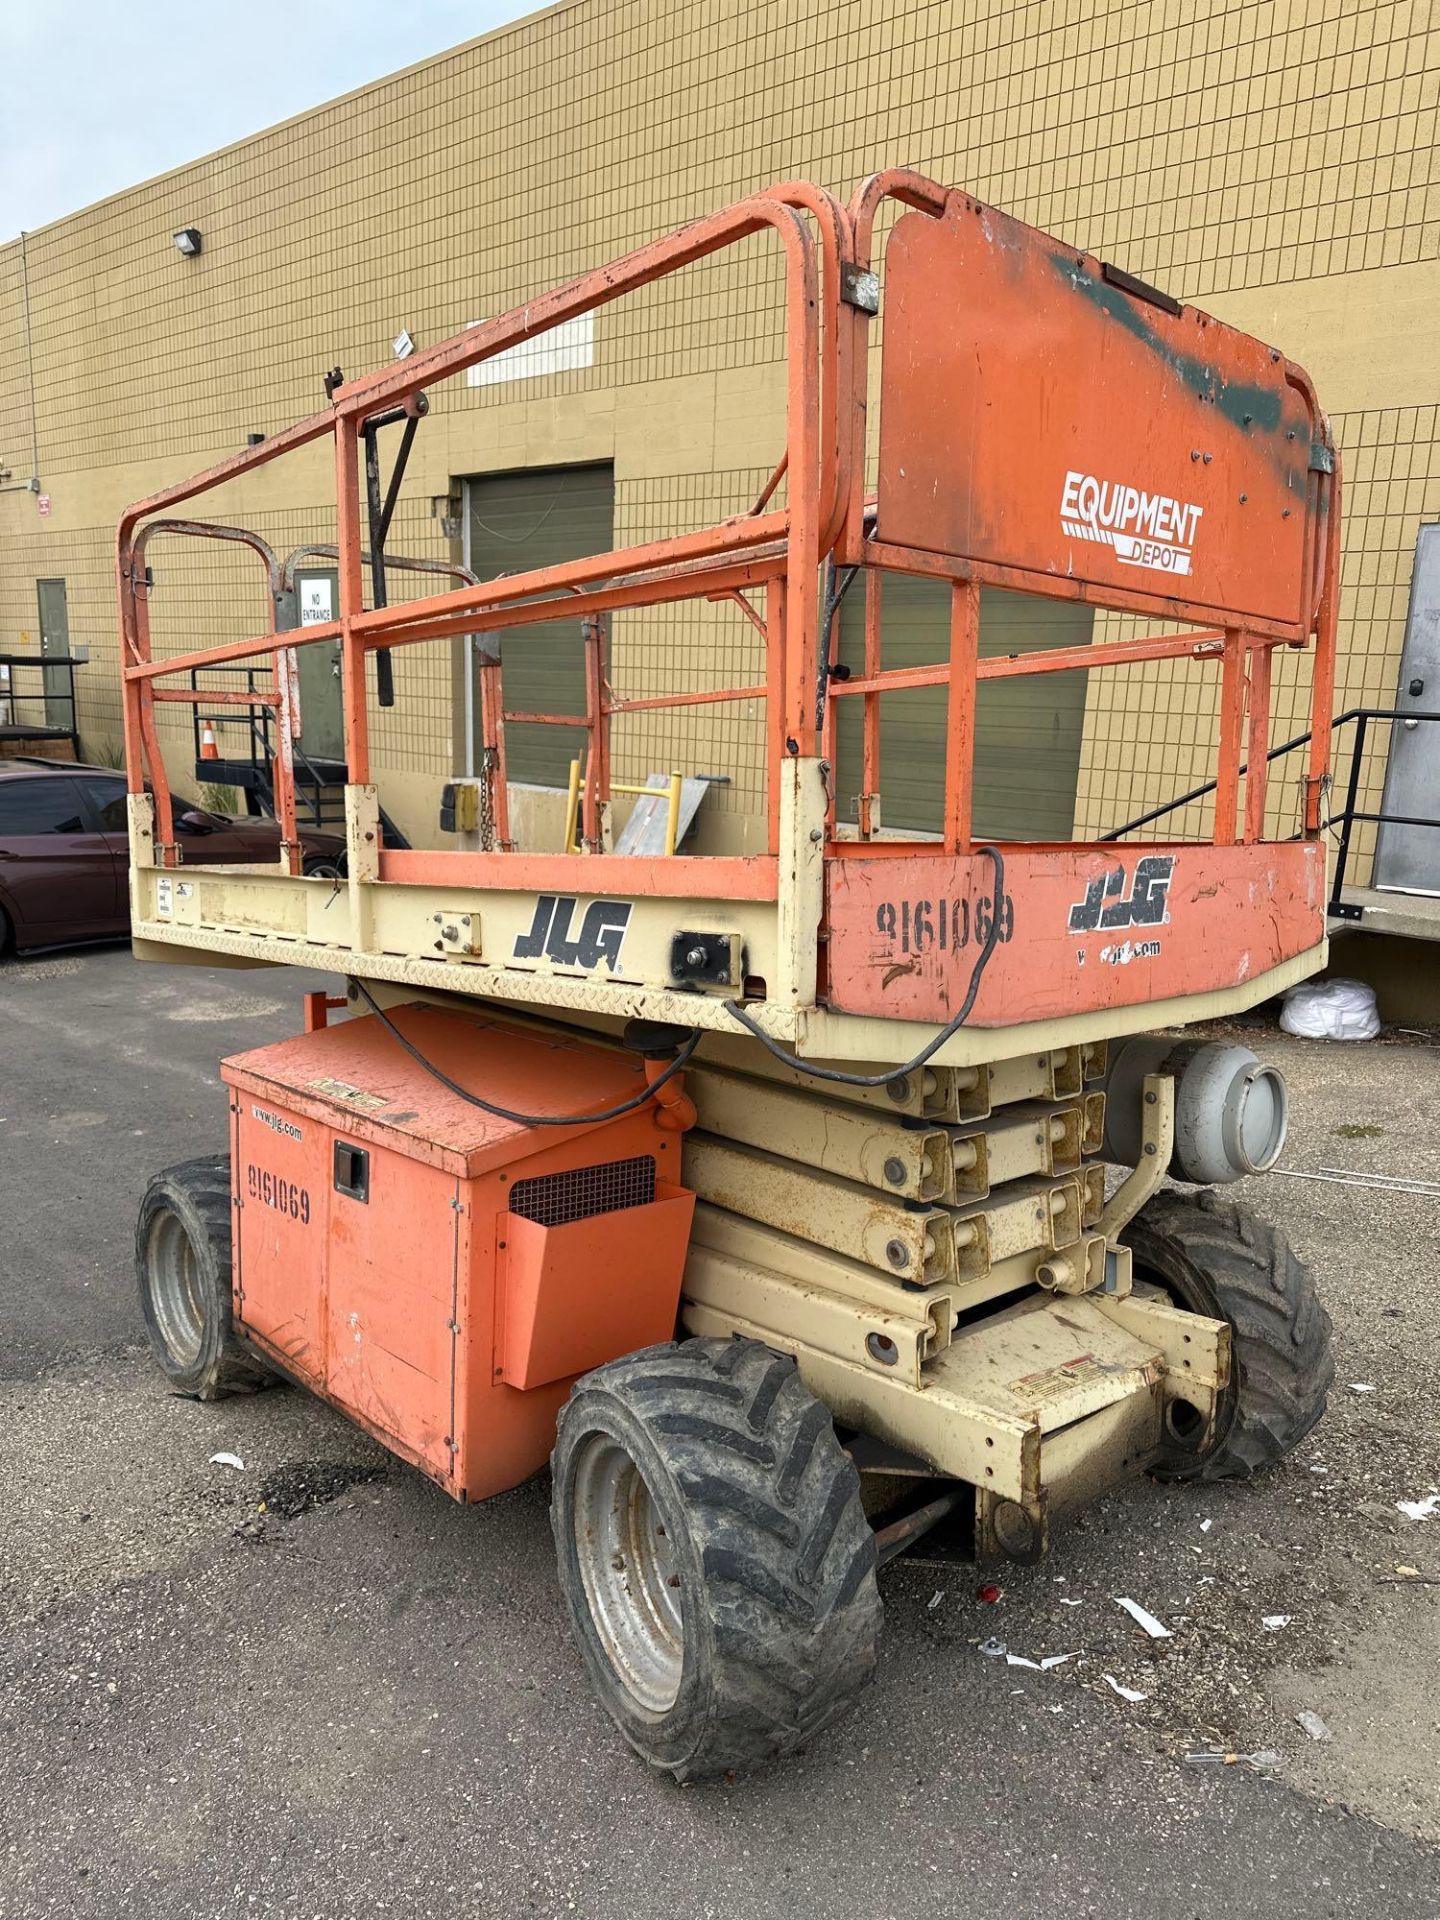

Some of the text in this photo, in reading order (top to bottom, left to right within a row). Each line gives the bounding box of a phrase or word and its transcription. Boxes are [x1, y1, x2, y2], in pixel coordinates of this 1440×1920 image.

[1060, 471, 1203, 545] EQUIPMENT
[1130, 541, 1180, 569] DEPOT
[303, 609, 330, 620] ENTRANCE
[311, 593, 320, 605] NO
[1067, 856, 1174, 933] JLG
[512, 895, 633, 972] JLG
[248, 1164, 310, 1225] 8161069
